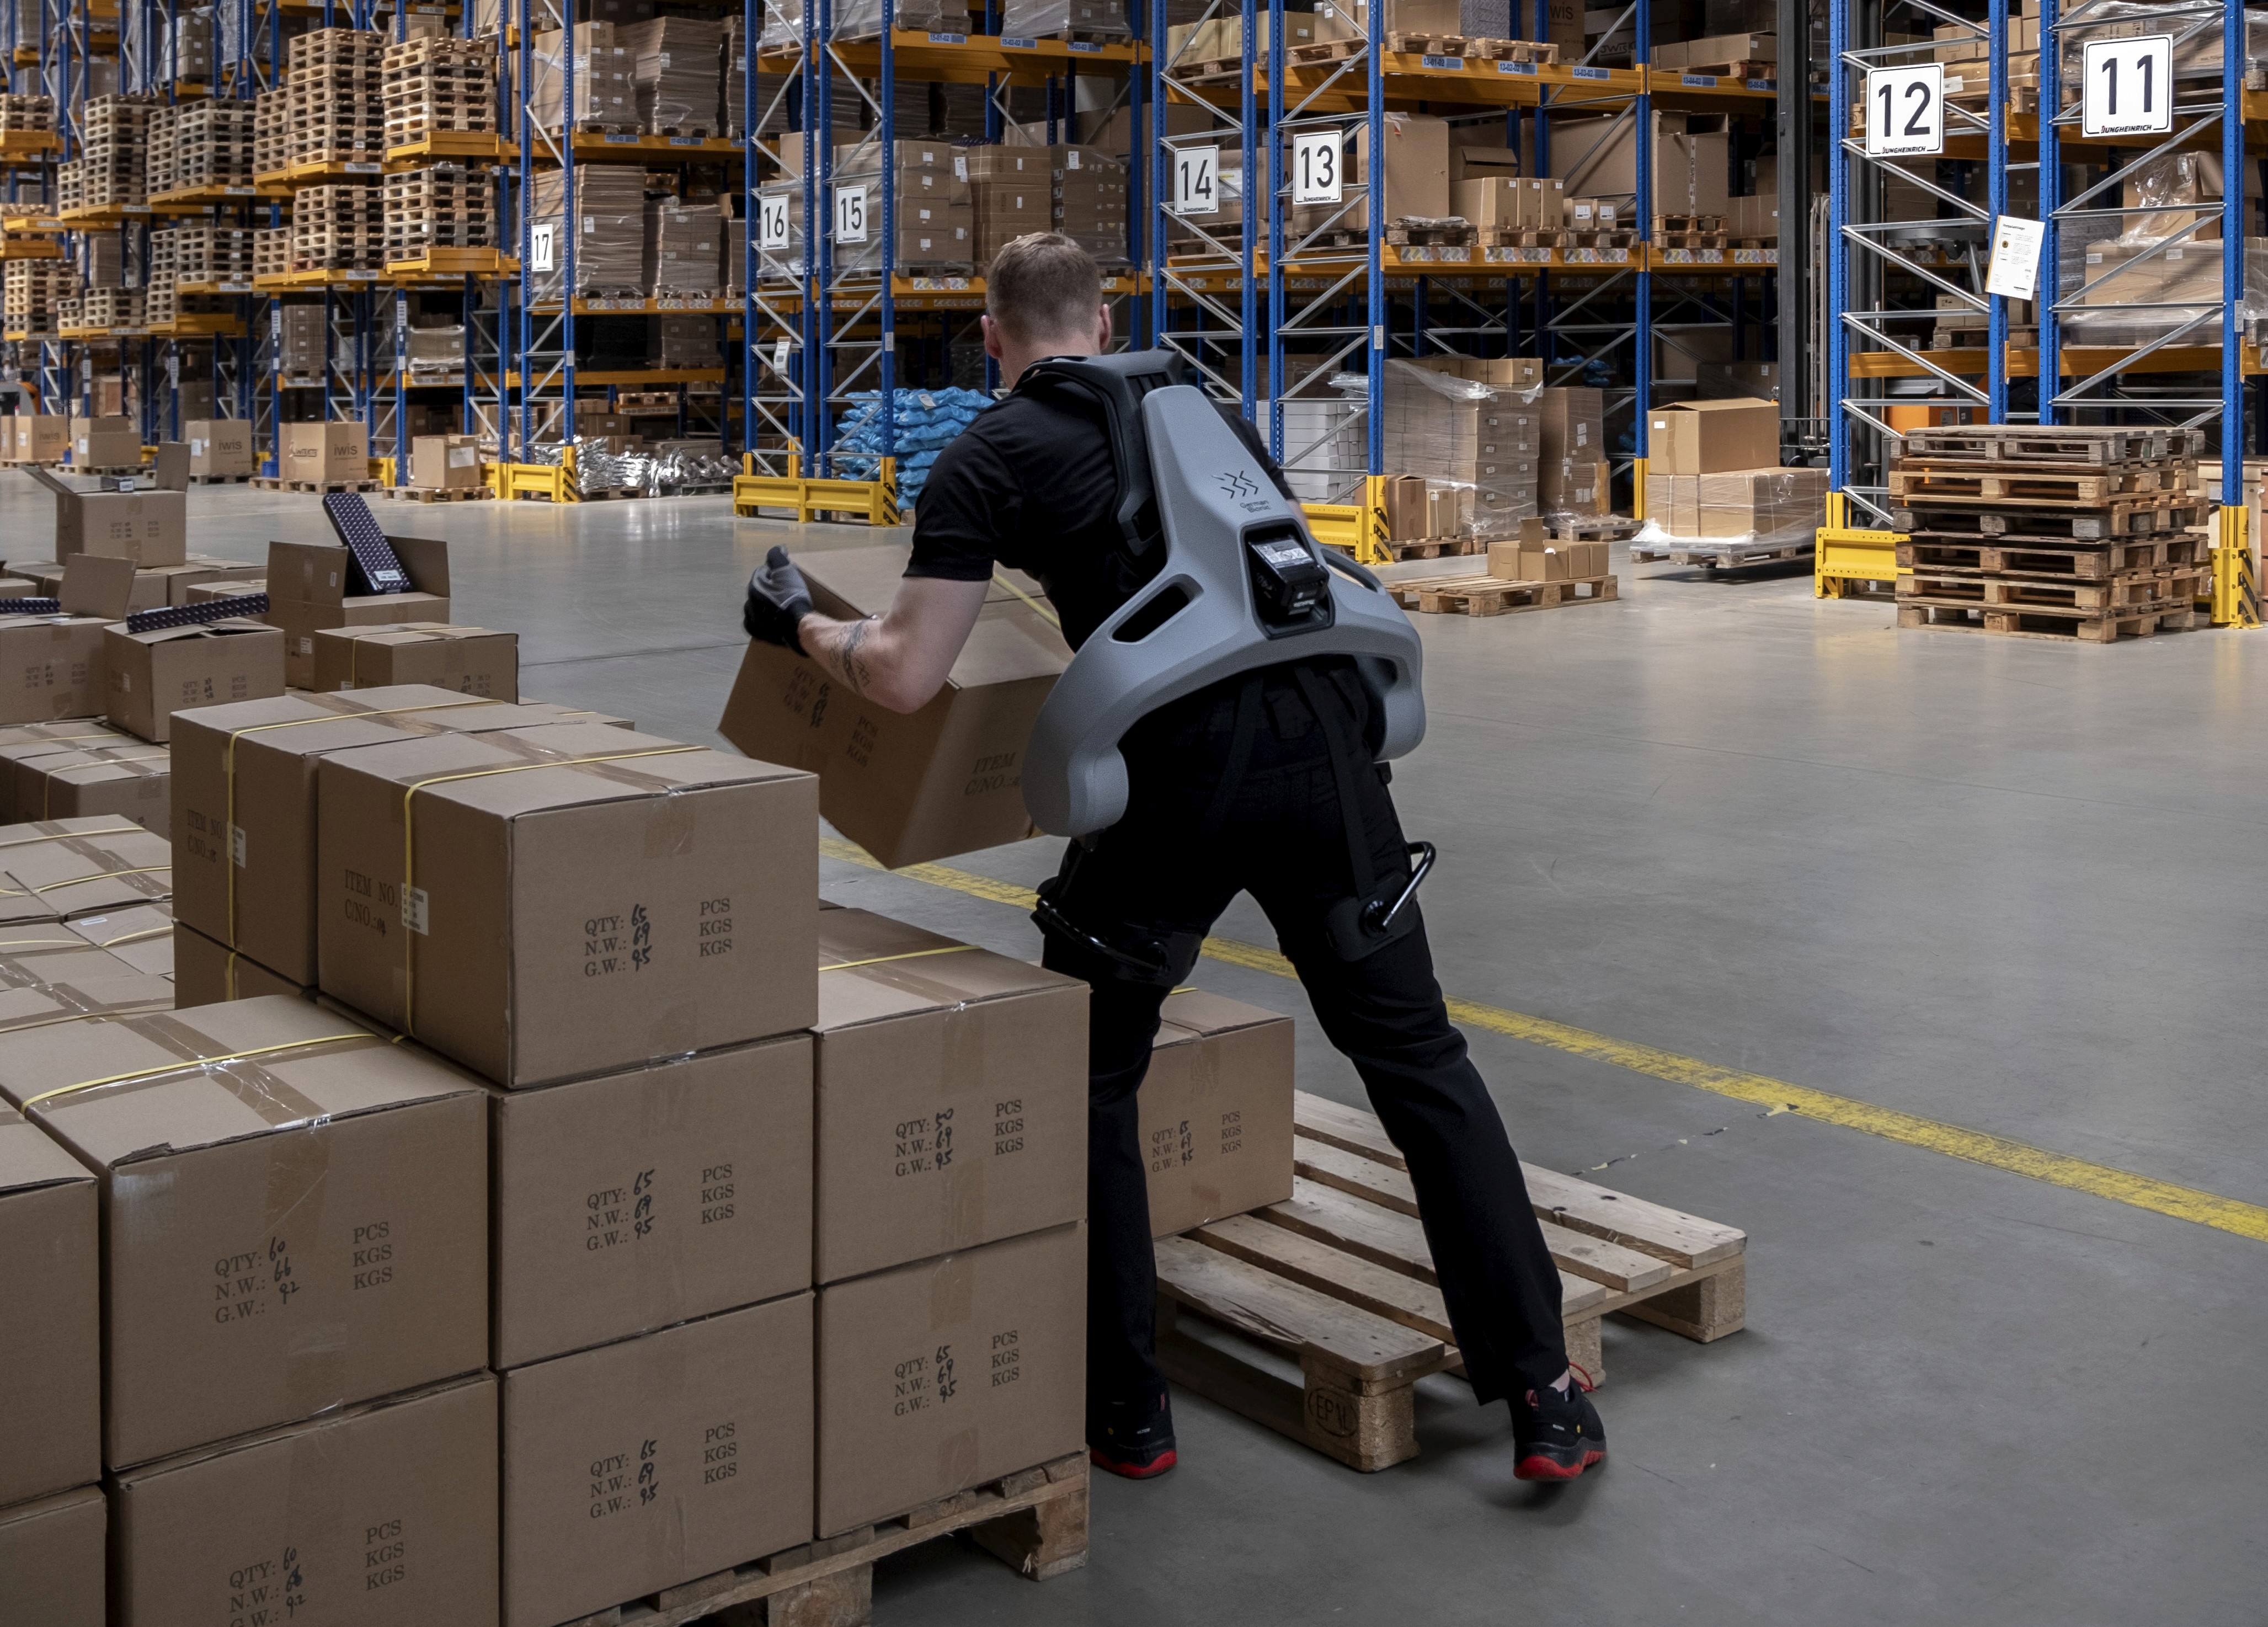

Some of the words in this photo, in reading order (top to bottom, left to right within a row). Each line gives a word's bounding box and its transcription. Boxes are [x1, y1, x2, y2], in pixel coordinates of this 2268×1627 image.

[1549, 2, 1573, 20] wis
[1423, 57, 1445, 67] 13-01-02
[2102, 55, 2153, 115] 11
[1879, 82, 1931, 137] 12
[2101, 125, 2152, 134] JUNGHEINRICH
[1301, 145, 1334, 189] 13
[1882, 146, 1927, 154] JUNGHEINRICH
[1181, 159, 1212, 201] 14
[765, 205, 785, 238] 16
[841, 196, 862, 231] 15
[535, 234, 549, 261] 17
[973, 752, 1016, 774] ITEM
[345, 869, 371, 898] ITEM
[584, 937, 626, 956] N.W.:
[699, 918, 732, 937] KGS
[585, 915, 624, 937] QTY:
[632, 904, 647, 926] 65
[700, 898, 730, 916] PCS
[585, 958, 626, 977] G.W.:
[699, 938, 732, 957] KGS
[895, 1119, 930, 1139] QTY:
[995, 1099, 1022, 1117] PCS
[895, 1139, 932, 1157] N.W.:
[995, 1118, 1024, 1137] KGS
[1152, 1128, 1176, 1145] QTY:
[1180, 1120, 1189, 1135] 65
[1222, 1111, 1241, 1125] PCS
[895, 1159, 931, 1177] G.W.:
[995, 1137, 1023, 1156] KGS
[1152, 1143, 1178, 1158] N.W.:
[1221, 1125, 1241, 1139] KGS
[1221, 1139, 1241, 1155] KGS
[587, 1188, 626, 1211] QTY:
[634, 1169, 655, 1195] 65
[702, 1164, 733, 1184] PCS
[587, 1209, 628, 1230] N.W.:
[701, 1183, 734, 1204] KGS
[586, 1230, 628, 1251] G.W.:
[701, 1204, 734, 1224] KGS
[215, 1251, 262, 1278] QTY:
[269, 1236, 285, 1261] 60
[353, 1221, 389, 1244] PCS
[215, 1276, 265, 1301] N.W.:
[353, 1244, 392, 1268] KGS
[215, 1300, 265, 1324] G.W.:
[353, 1266, 392, 1290] KGS
[894, 1377, 930, 1398] N.W.:
[991, 1348, 1020, 1369] KGS
[895, 1357, 928, 1379] QTY:
[936, 1345, 951, 1364] 65
[992, 1330, 1018, 1349] PCS
[894, 1396, 930, 1417] G.W.:
[991, 1367, 1020, 1387] KGS
[590, 1454, 629, 1478] QTY:
[641, 1439, 658, 1460] 65
[705, 1422, 735, 1443] PCS
[590, 1475, 632, 1497] N.W.:
[704, 1442, 737, 1464] KGS
[590, 1496, 631, 1518] G.W.:
[704, 1462, 737, 1485] KGS
[230, 1560, 276, 1589] QTY:
[284, 1546, 296, 1571] 60
[365, 1519, 402, 1545] PCS
[229, 1586, 279, 1613] N.W.:
[365, 1542, 404, 1568] KGS
[366, 1564, 405, 1591] KGS
